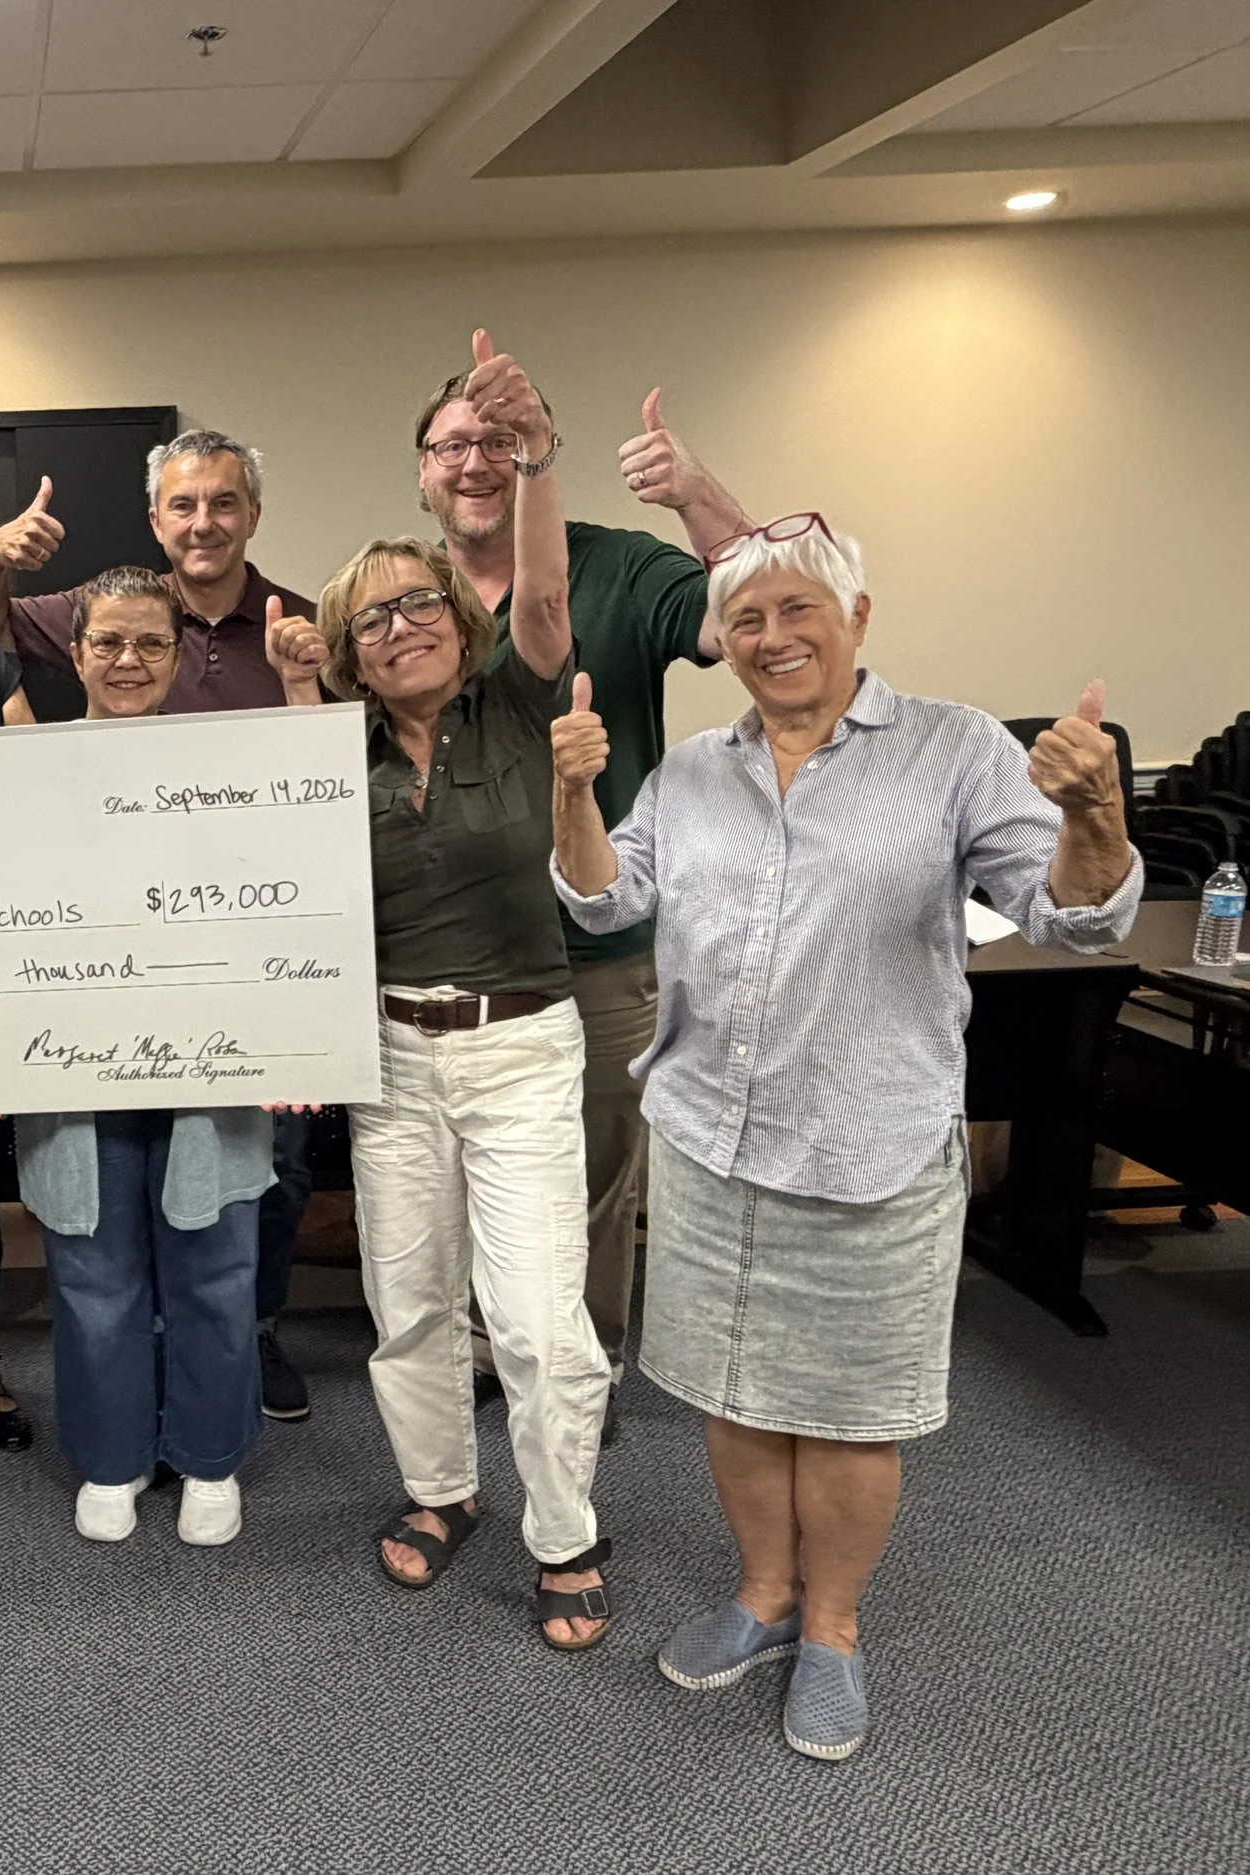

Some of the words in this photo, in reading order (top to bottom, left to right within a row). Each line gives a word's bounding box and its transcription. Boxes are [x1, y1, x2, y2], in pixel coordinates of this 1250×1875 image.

[103, 796, 148, 815] Date:
[154, 784, 259, 814] September
[14, 954, 146, 984] thousand
[262, 957, 342, 982] Dollars
[97, 1064, 187, 1083] Authorized
[188, 1061, 266, 1085] Signature
